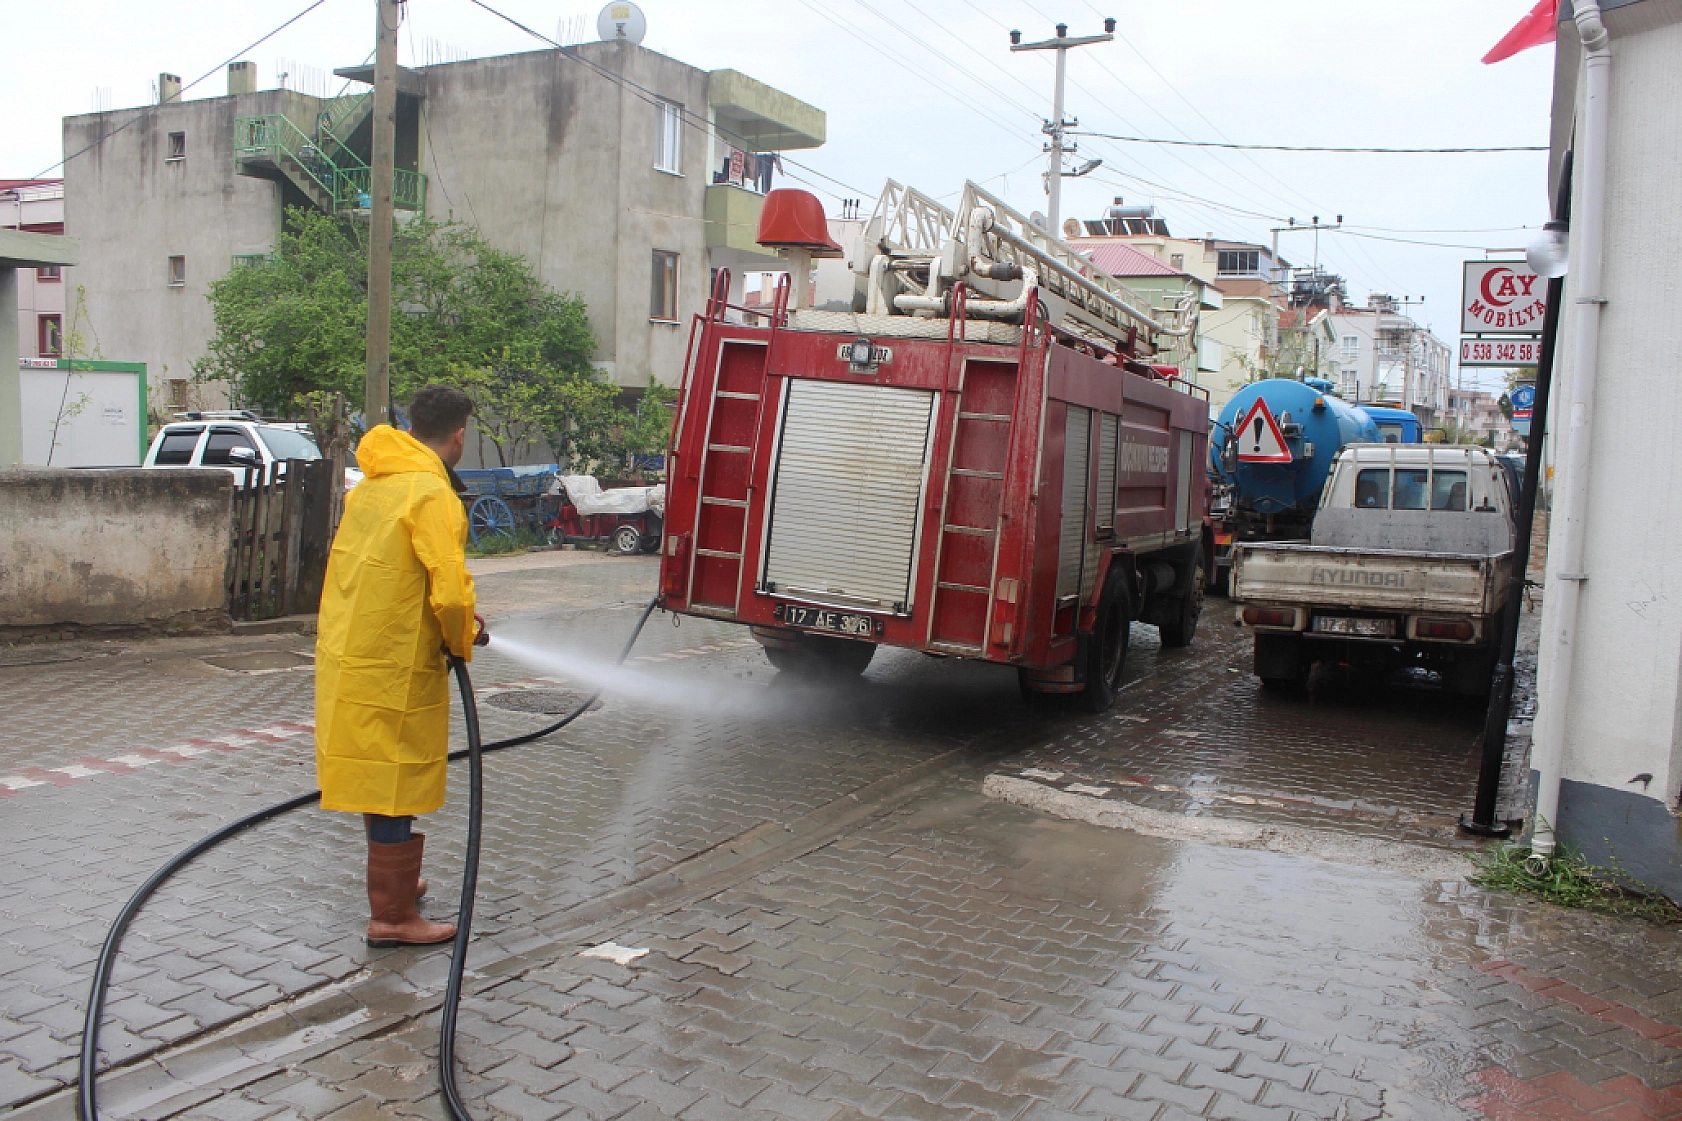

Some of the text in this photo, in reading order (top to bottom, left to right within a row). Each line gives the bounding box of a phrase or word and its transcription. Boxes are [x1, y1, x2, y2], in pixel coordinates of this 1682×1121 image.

[1463, 343, 1470, 360] 0
[1496, 343, 1516, 360] 342
[1519, 343, 1532, 360] 58
[1311, 568, 1405, 588] HYUNDAI
[790, 607, 807, 624] 17
[815, 611, 836, 629] AE
